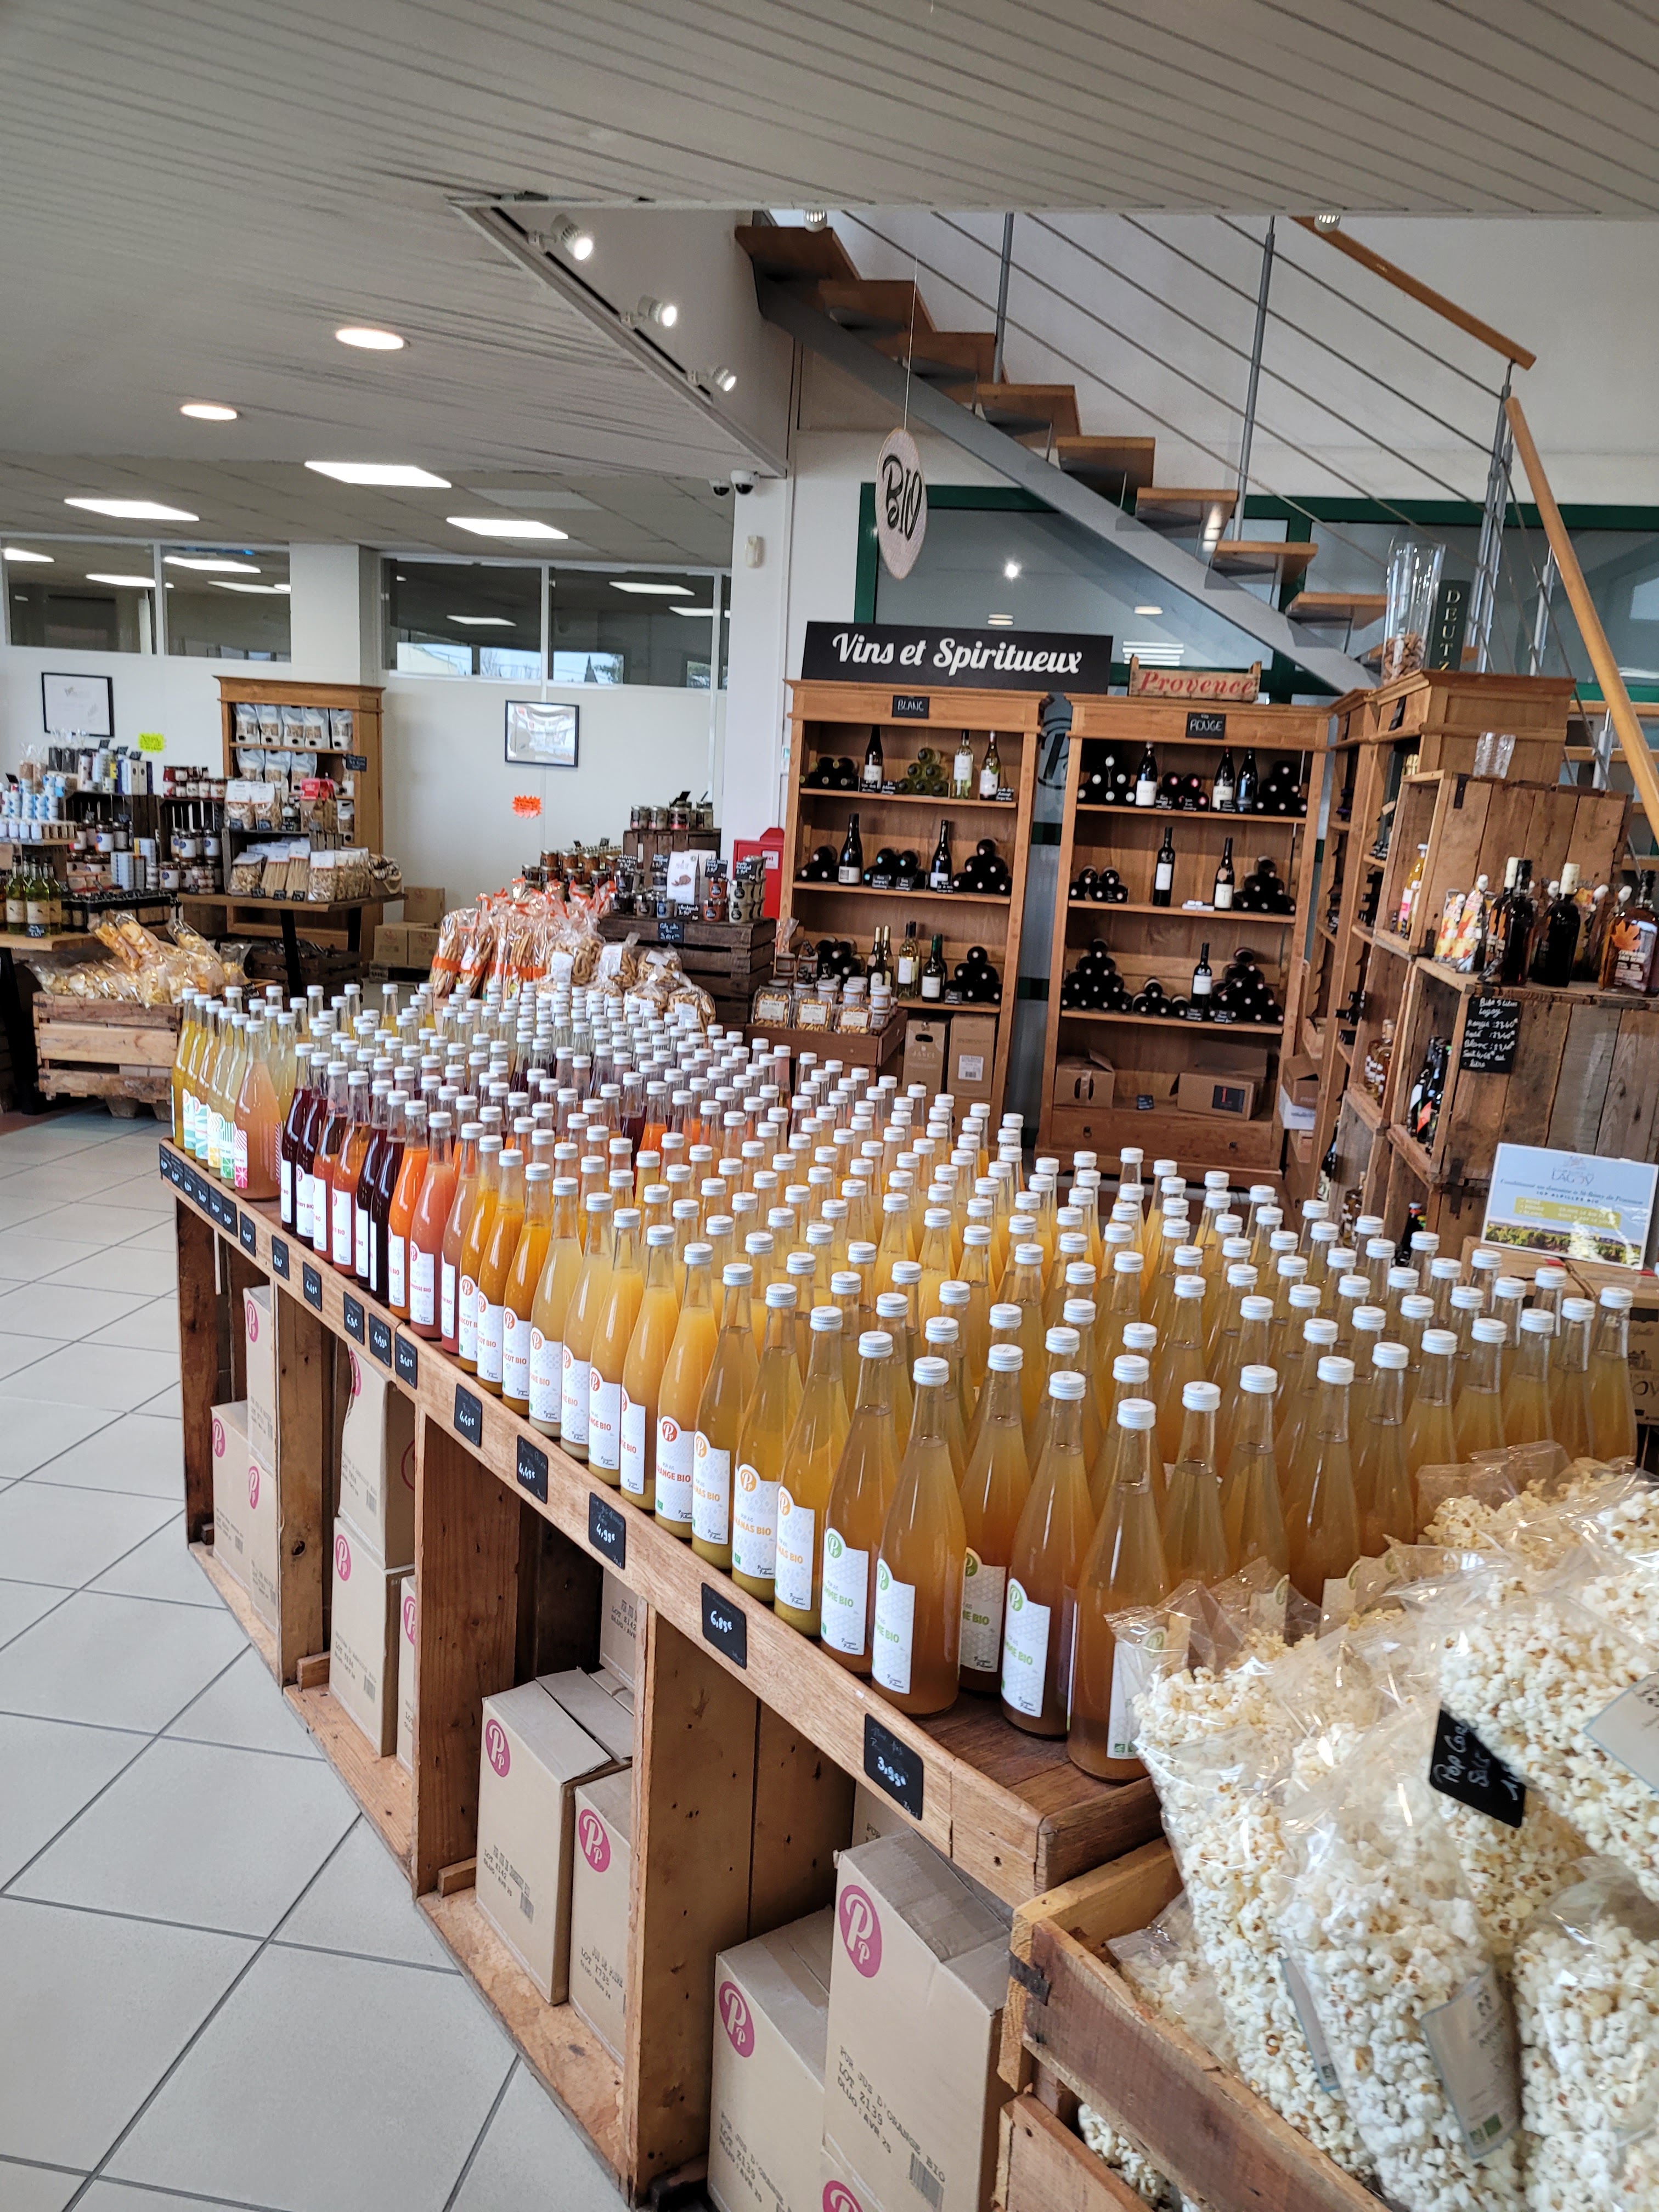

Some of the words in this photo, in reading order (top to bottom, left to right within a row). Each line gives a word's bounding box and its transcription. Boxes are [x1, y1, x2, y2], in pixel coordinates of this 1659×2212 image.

[882, 454, 922, 541] BIO
[1438, 589, 1462, 672] DEUTZ
[832, 633, 893, 665] Vins
[899, 640, 922, 665] et
[933, 637, 1082, 677] Spiritueux
[1139, 671, 1255, 696] Provence
[896, 700, 925, 713] BLANC
[1189, 718, 1224, 733] ROUGE
[486, 1340, 496, 1348] BIO
[515, 1356, 527, 1365] BIO
[539, 1378, 550, 1386] BIO
[568, 1397, 578, 1407] BIO
[600, 1422, 612, 1431] BIO
[627, 1443, 637, 1454] BIO
[676, 1474, 691, 1482] BIO
[707, 1493, 721, 1502] BIO
[757, 1527, 772, 1537] BIO
[790, 1553, 804, 1564] BIO
[839, 1596, 854, 1608] BIO
[973, 1613, 990, 1626] BIO
[885, 1629, 900, 1644] BIO
[1017, 1651, 1034, 1666] BIO
[839, 2061, 855, 2089] LOT
[926, 2155, 946, 2183] BIO
